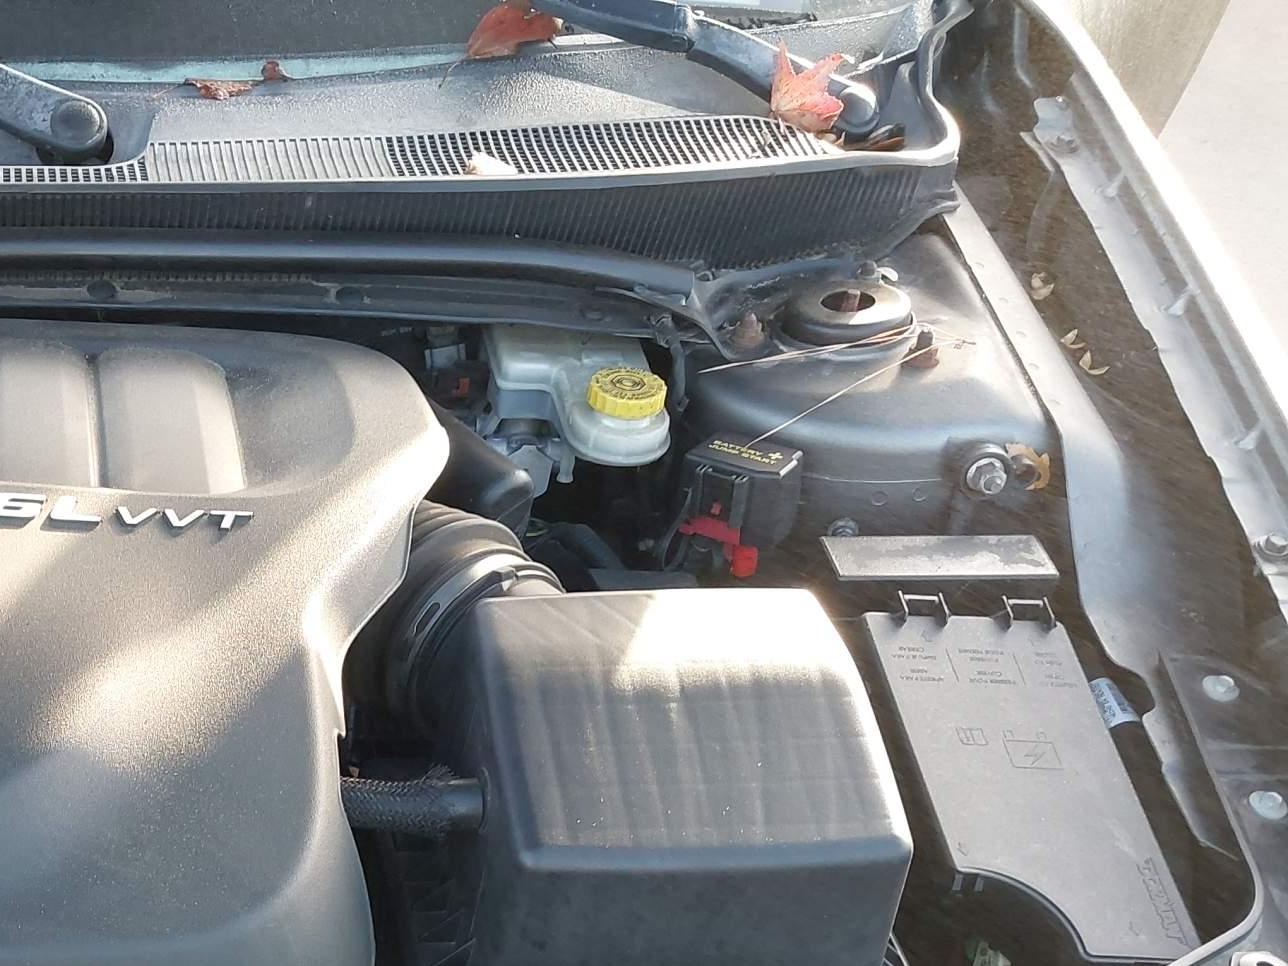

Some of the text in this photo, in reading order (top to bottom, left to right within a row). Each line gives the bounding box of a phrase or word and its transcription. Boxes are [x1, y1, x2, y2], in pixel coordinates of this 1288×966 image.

[708, 444, 777, 465] JUMP START
[713, 440, 764, 456] BATTERY
[115, 505, 255, 533] VVT
